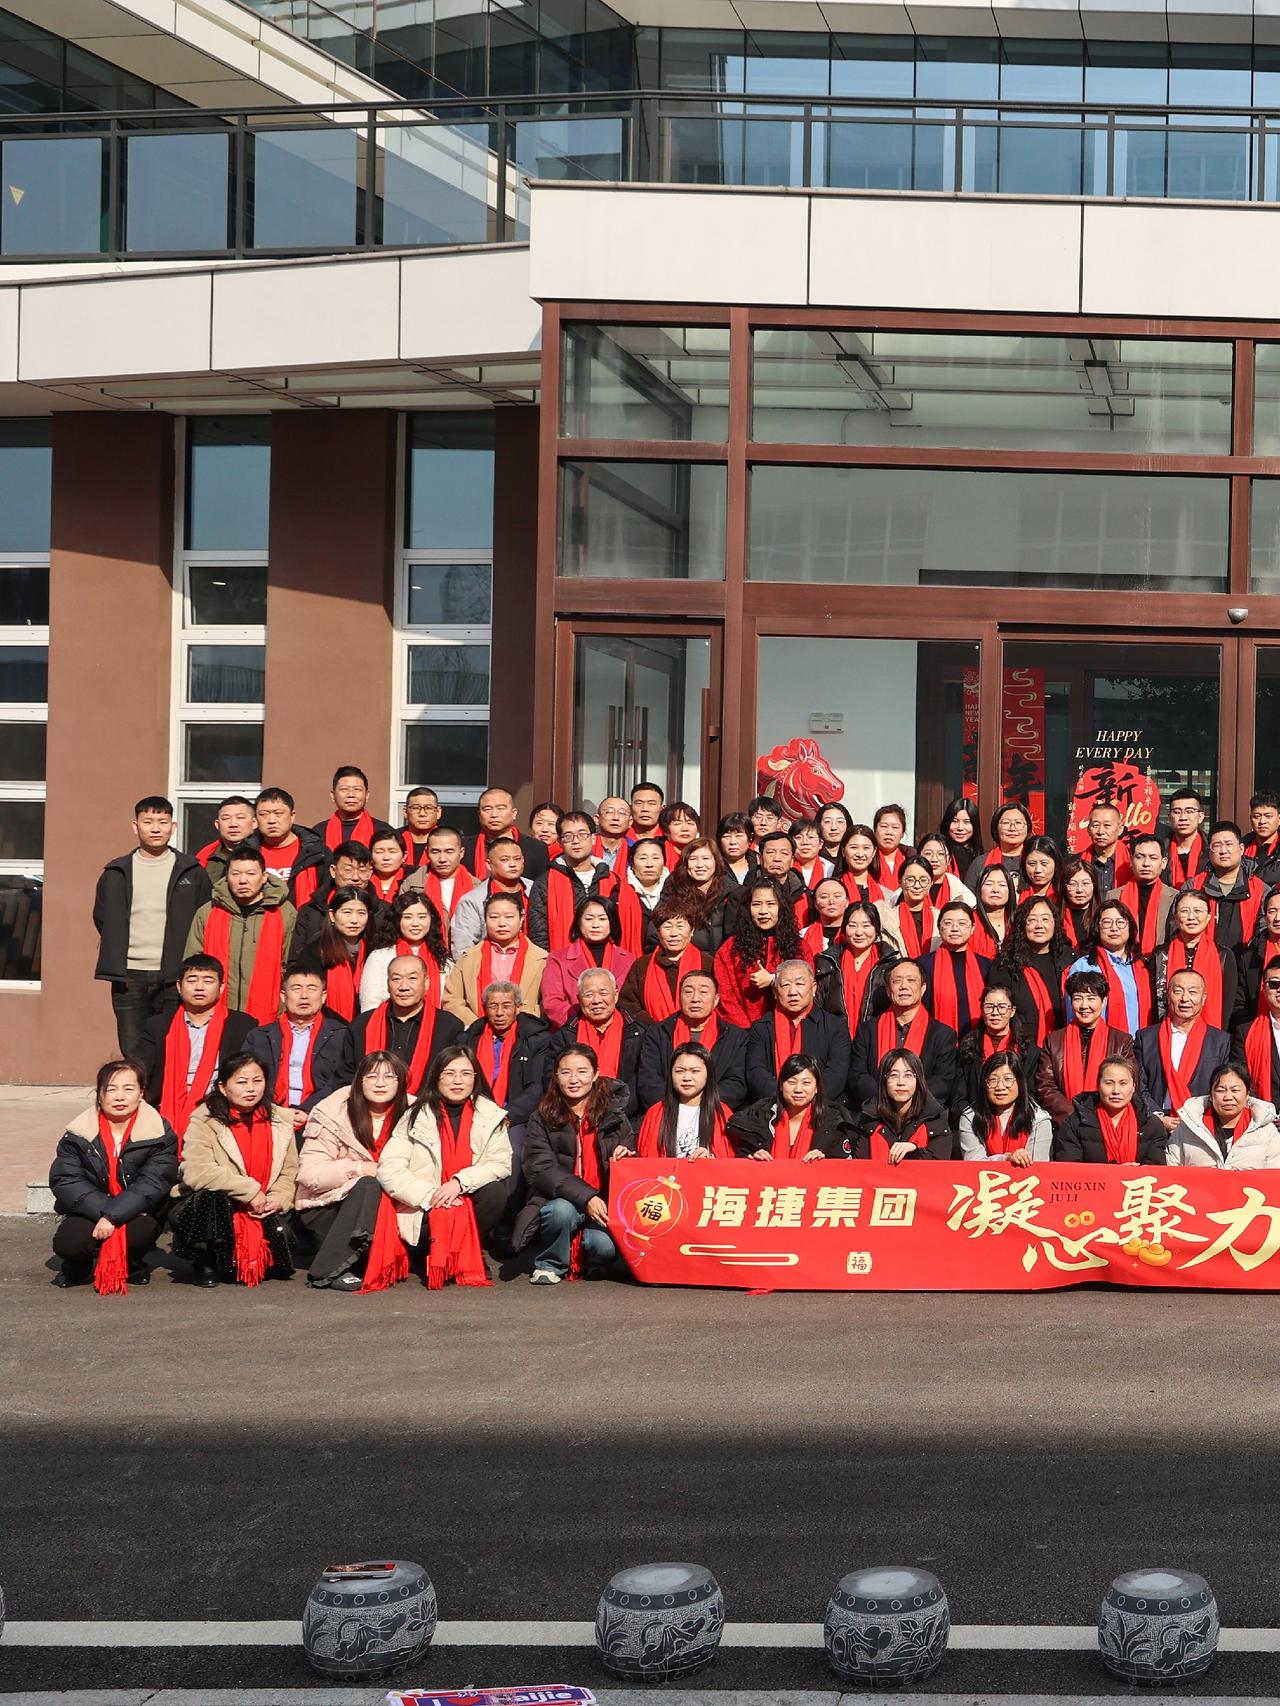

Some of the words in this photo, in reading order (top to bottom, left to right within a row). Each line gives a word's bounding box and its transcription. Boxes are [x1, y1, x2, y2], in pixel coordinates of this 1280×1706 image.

[1096, 730, 1143, 742] HAPPY
[1075, 747, 1123, 759] EVERY
[1124, 747, 1155, 759] DAY
[1050, 1181, 1082, 1191] NING
[1083, 1182, 1107, 1191] XIN
[1049, 1193, 1064, 1203] JU
[640, 1200, 663, 1222] 福
[696, 1186, 917, 1228] 海捷集团
